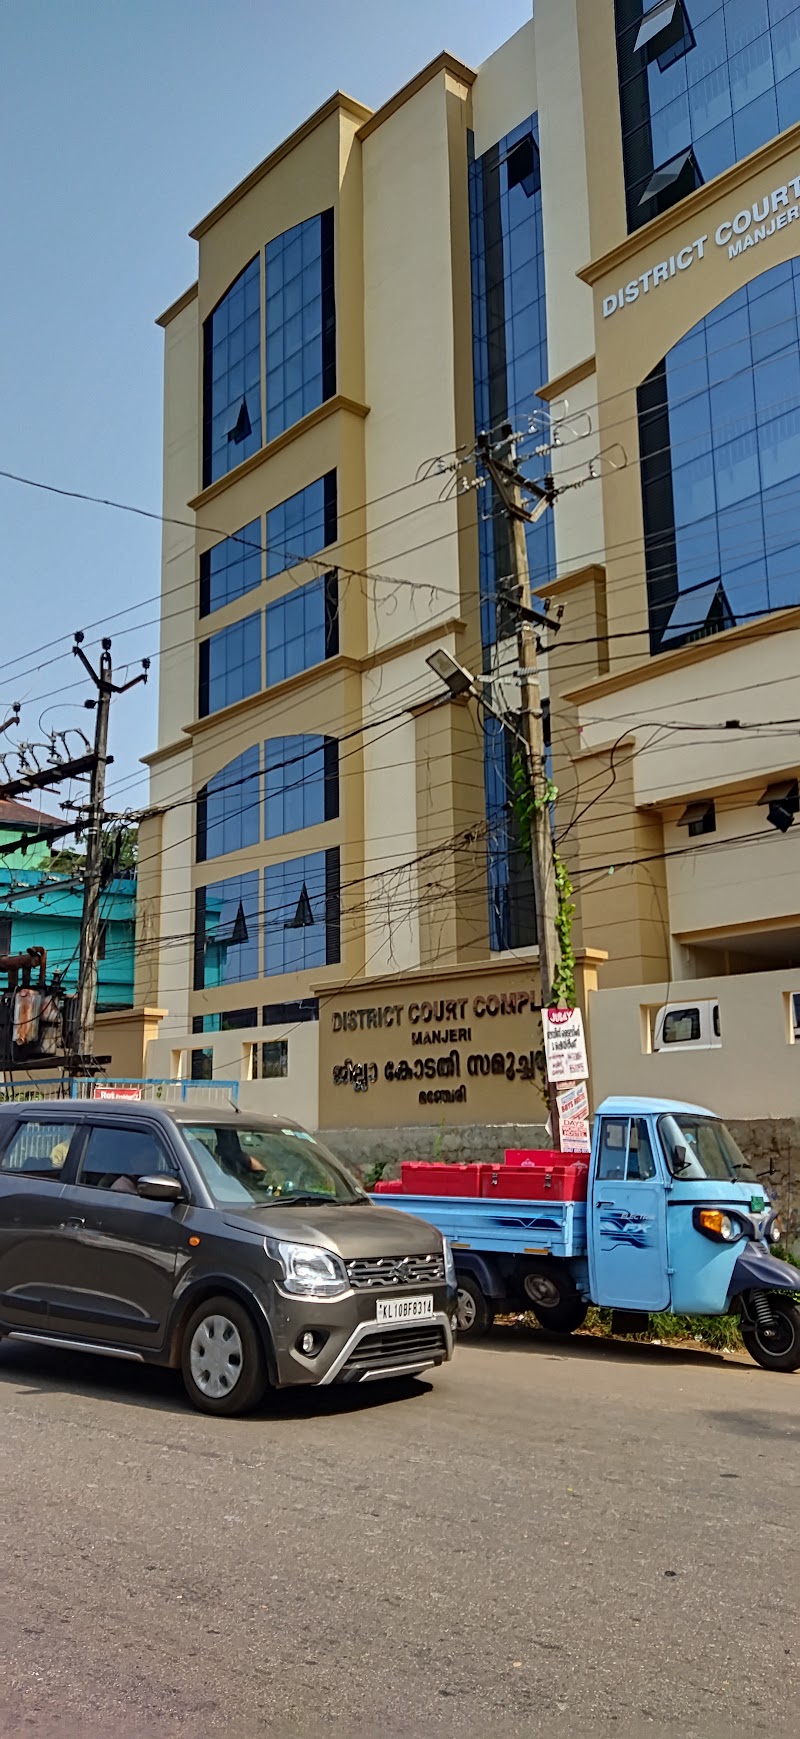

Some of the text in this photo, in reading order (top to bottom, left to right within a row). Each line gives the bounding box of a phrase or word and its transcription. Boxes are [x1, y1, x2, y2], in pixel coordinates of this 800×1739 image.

[602, 175, 800, 318] DISTRICT COURT
[728, 204, 800, 260] MANJER
[332, 990, 544, 1033] DISTRICT COURT COMPL
[411, 1028, 472, 1045] MANJERI
[332, 1058, 378, 1093] ജില്ലാ
[384, 1050, 461, 1082] കോടതി
[563, 1119, 585, 1128] DAYS
[382, 1300, 432, 1319] KL10BF8314
